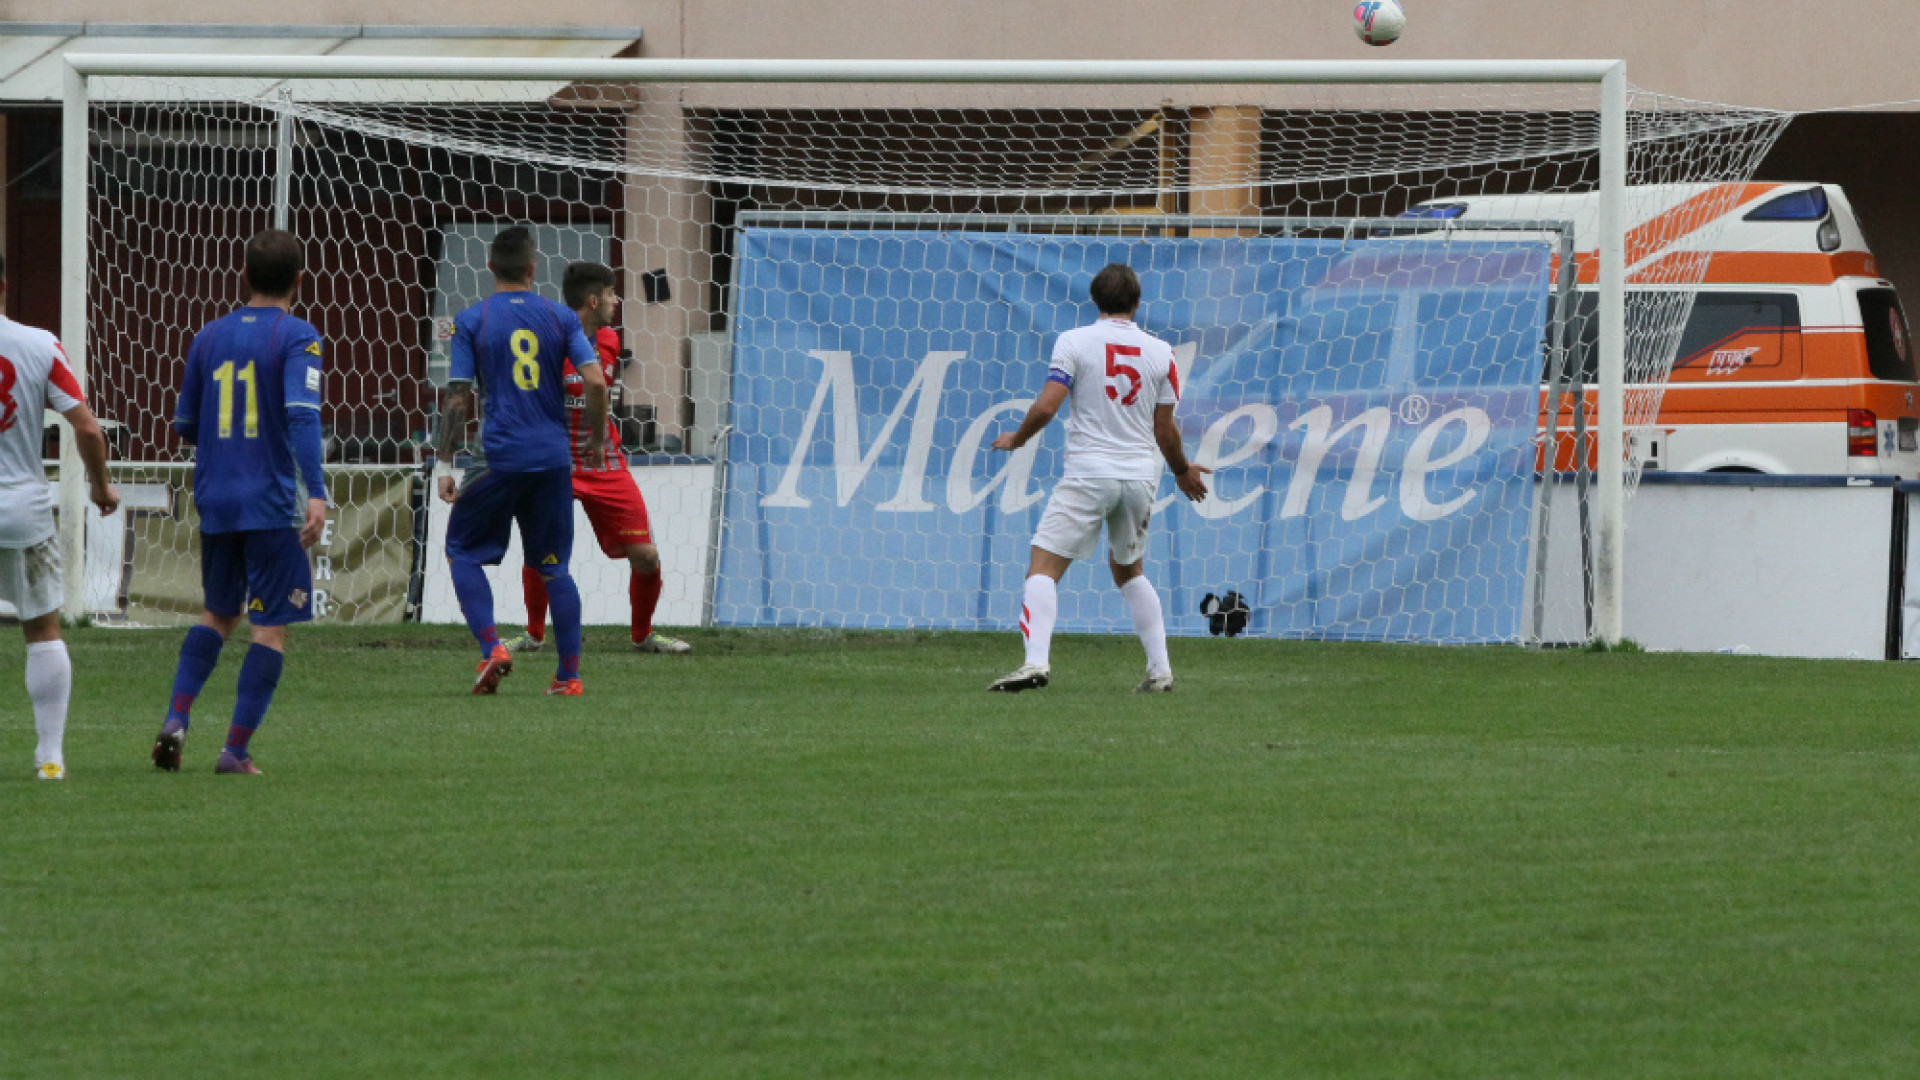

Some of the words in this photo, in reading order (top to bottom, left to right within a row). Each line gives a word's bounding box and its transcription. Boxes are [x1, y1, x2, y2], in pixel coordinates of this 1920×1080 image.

[511, 329, 539, 391] 8
[1105, 342, 1141, 406] 5
[212, 360, 258, 438] 11
